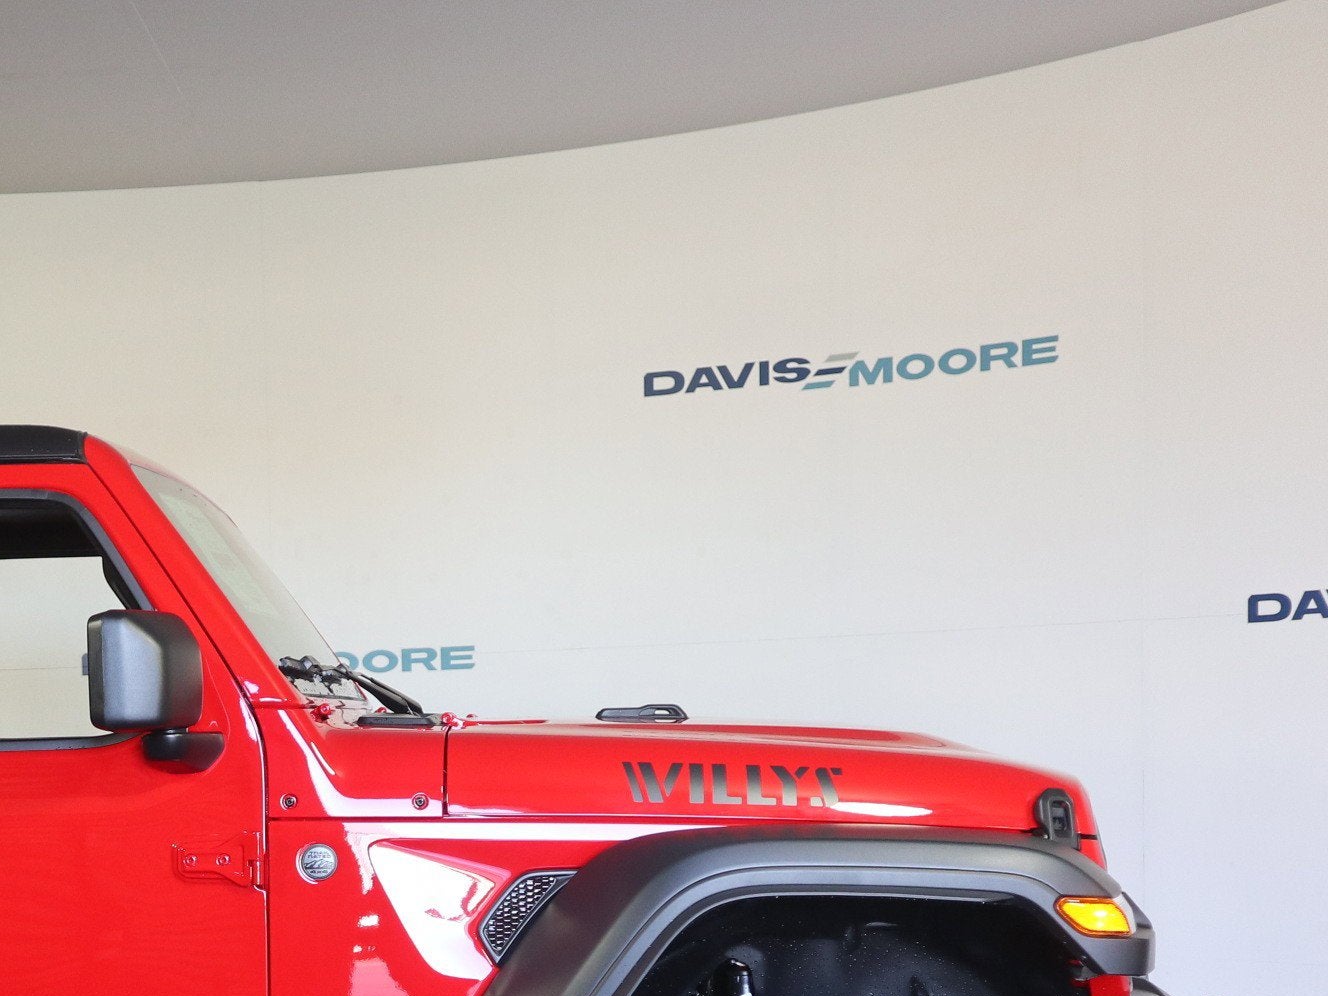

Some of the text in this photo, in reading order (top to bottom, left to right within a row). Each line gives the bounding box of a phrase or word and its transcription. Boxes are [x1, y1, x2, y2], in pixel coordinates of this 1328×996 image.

[643, 334, 1059, 397] DAVIS MOORE
[1247, 589, 1328, 623] DA
[622, 761, 843, 807] WILLYS
